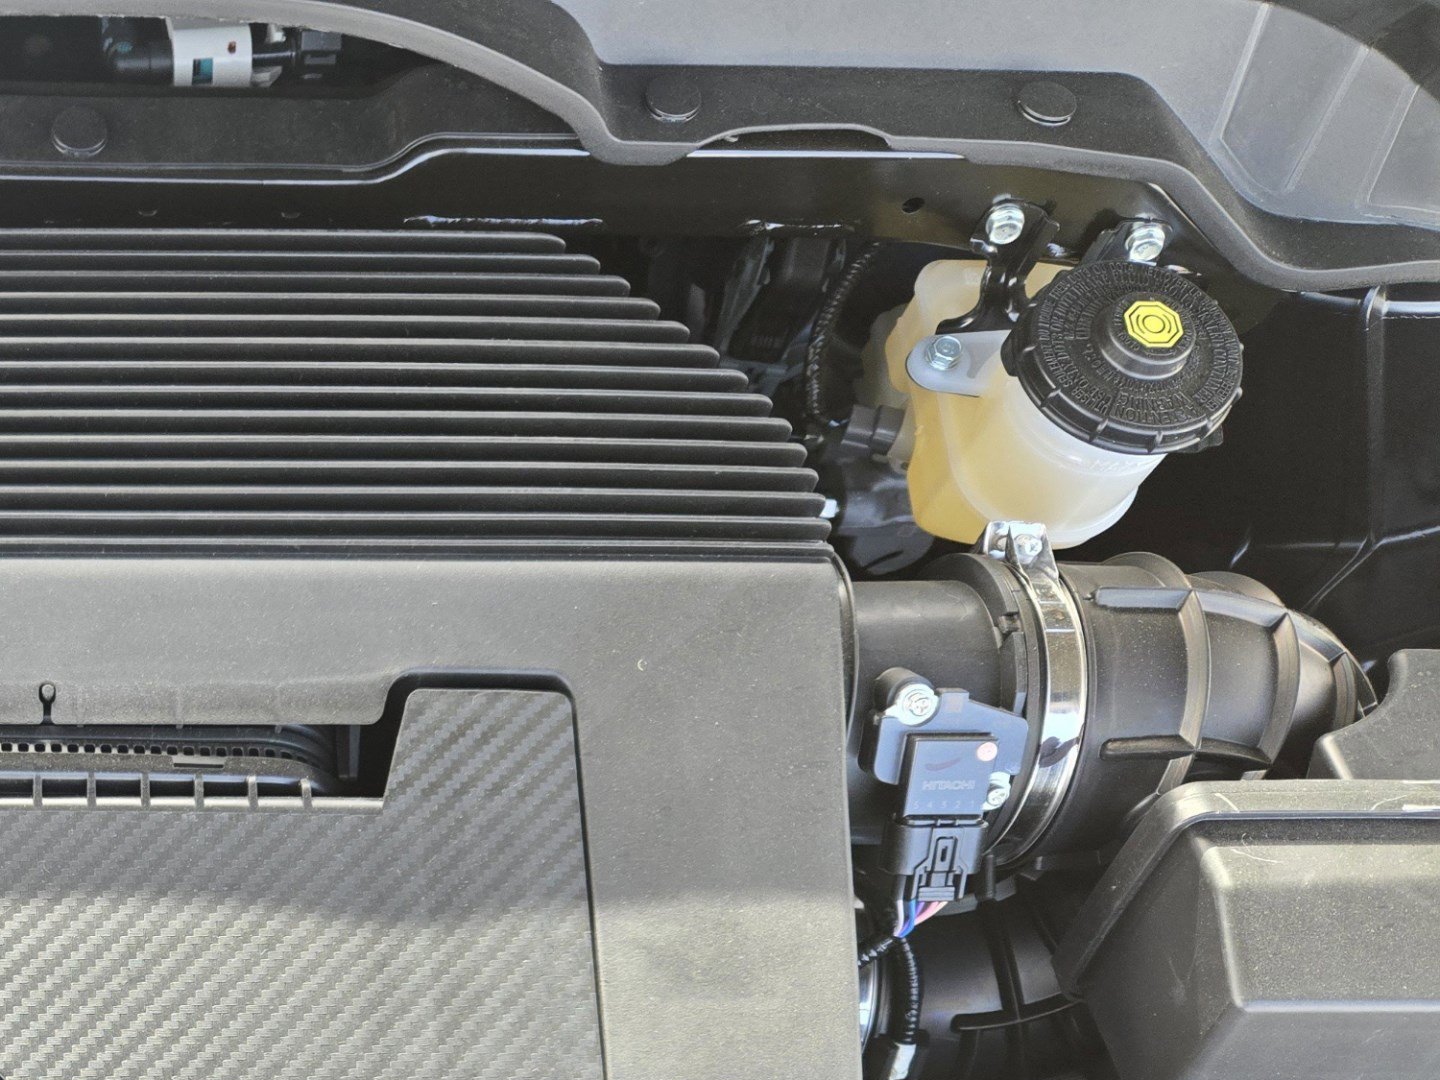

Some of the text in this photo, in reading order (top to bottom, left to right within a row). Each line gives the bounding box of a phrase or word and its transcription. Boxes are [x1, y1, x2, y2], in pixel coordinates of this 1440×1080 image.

[1059, 359, 1090, 391] ONLY
[1190, 348, 1229, 406] CONTAINER
[1087, 385, 1114, 407] USE
[921, 779, 976, 790] HITACHI
